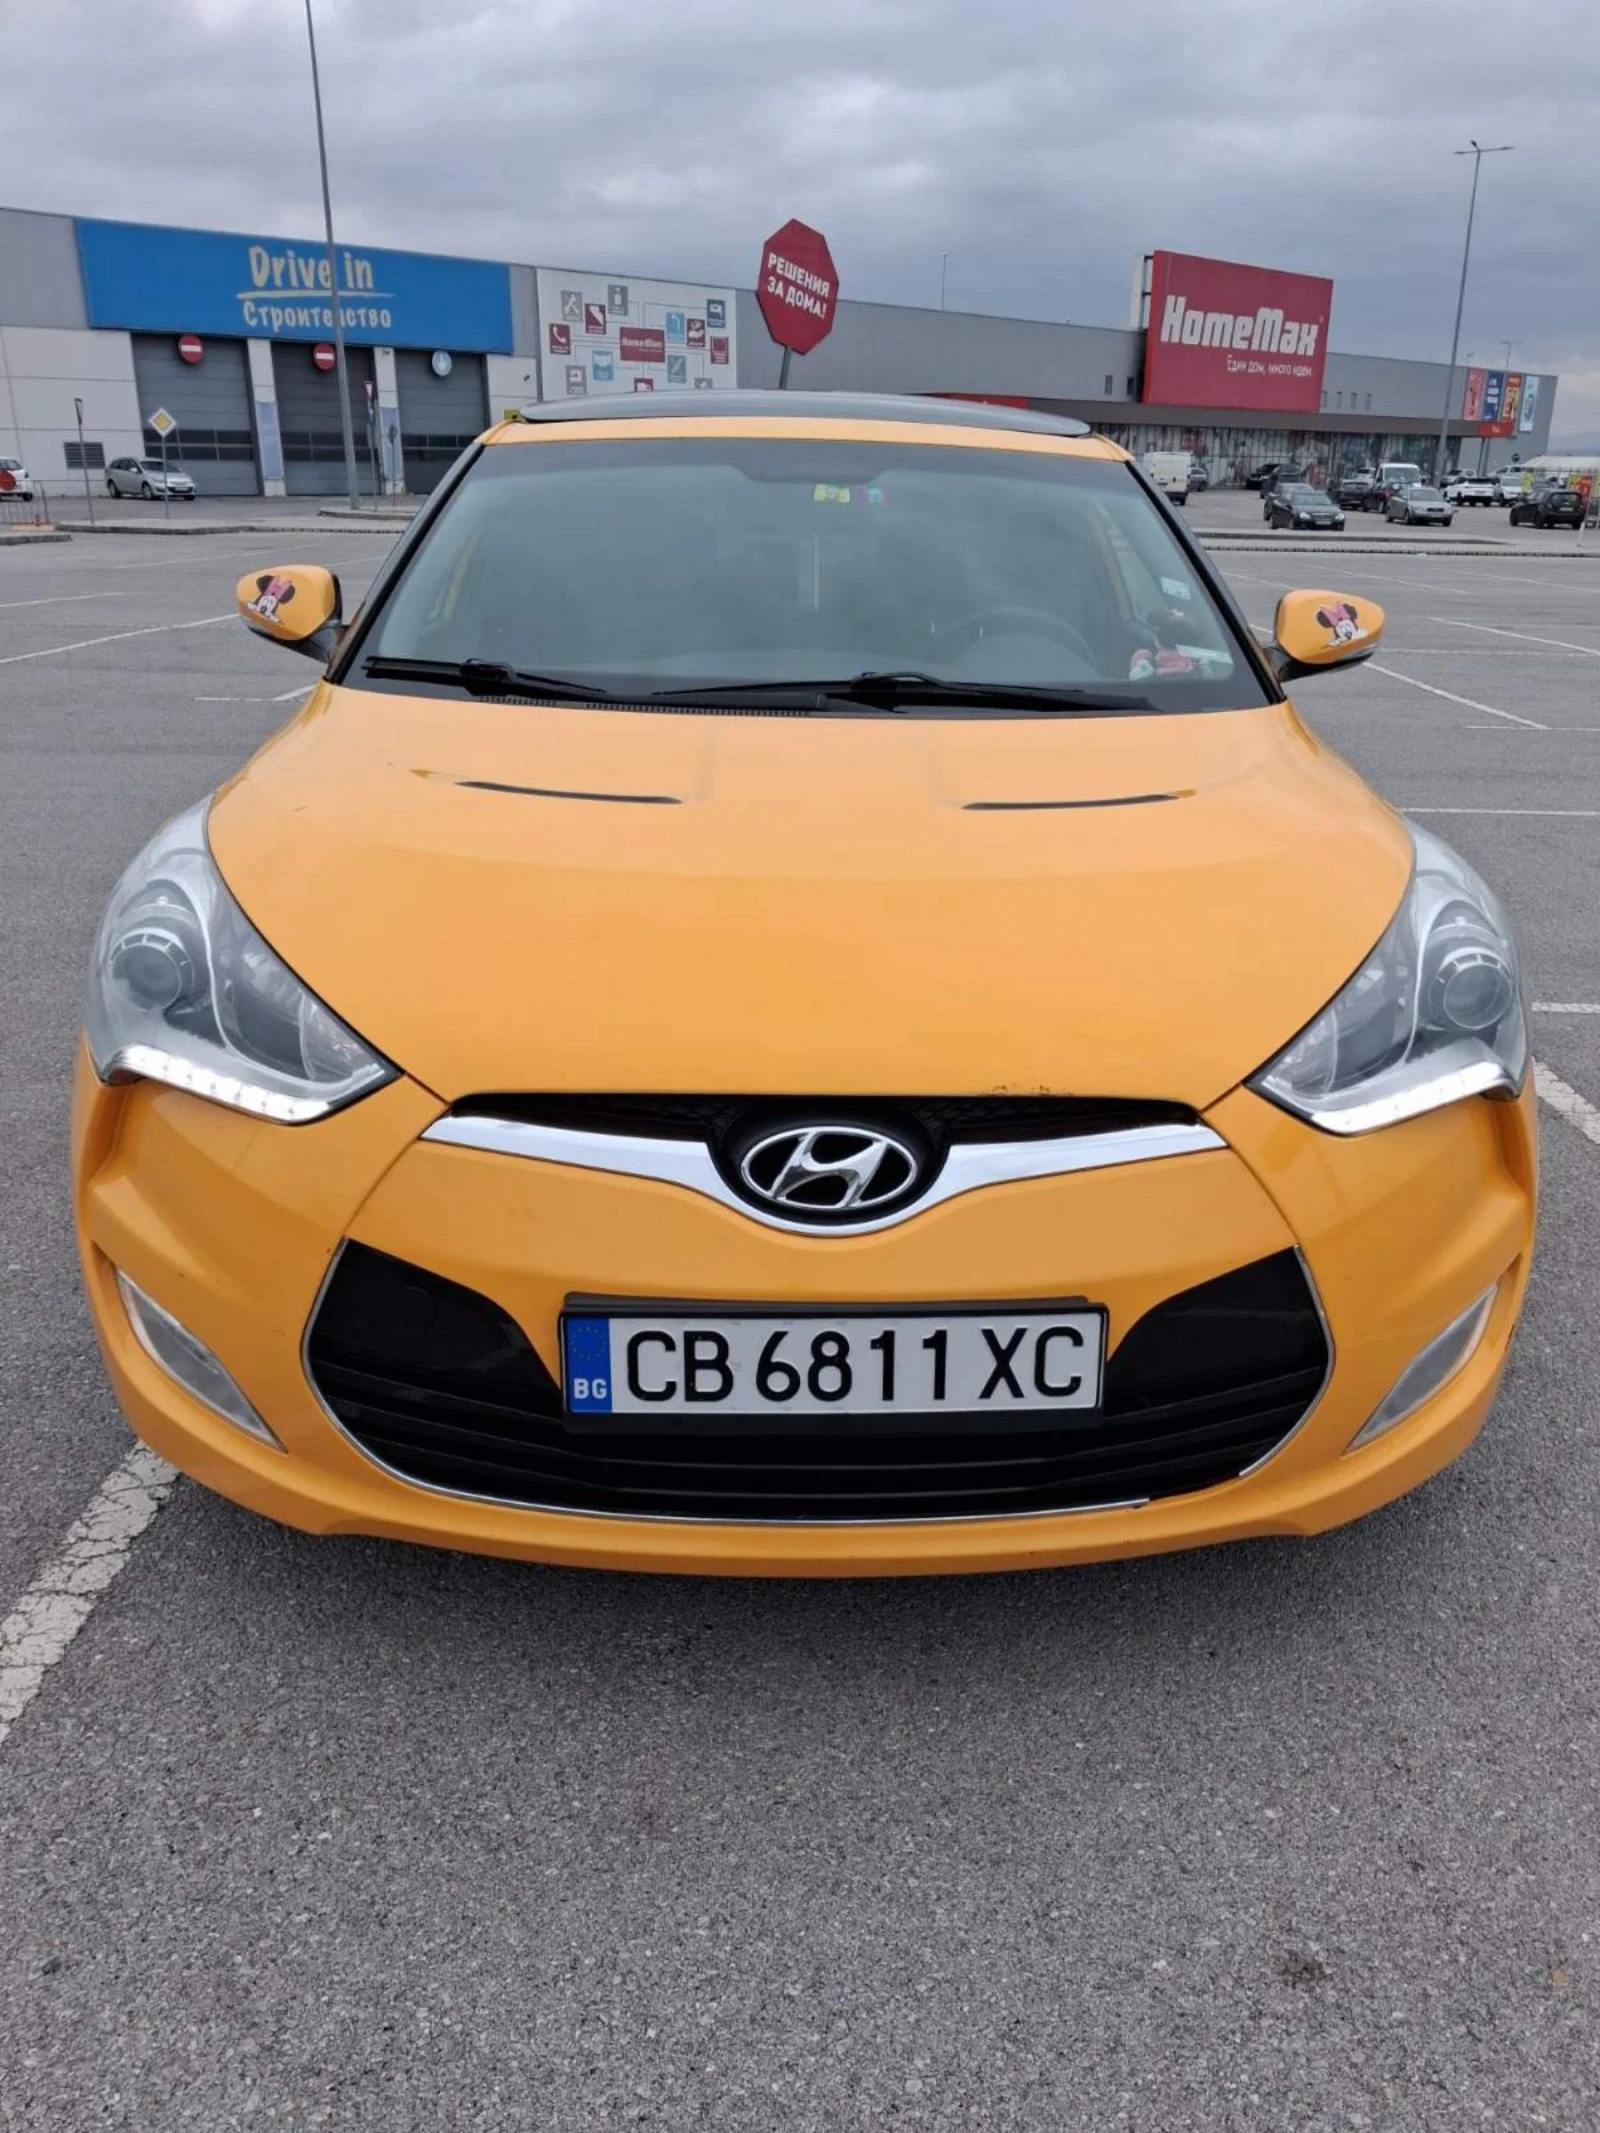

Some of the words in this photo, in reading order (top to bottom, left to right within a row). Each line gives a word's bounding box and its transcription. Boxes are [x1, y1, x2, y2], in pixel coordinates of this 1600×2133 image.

[248, 245, 332, 288] Drive
[343, 251, 374, 289] in
[767, 253, 831, 297] РЕШЕНИЯ
[767, 276, 783, 297] ЗА
[784, 286, 828, 320] ДОМА!
[1160, 294, 1319, 356] HomeMax
[626, 1329, 734, 1403] CB
[755, 1328, 948, 1402] 6811
[979, 1326, 1085, 1400] XC
[574, 1378, 607, 1400] BG
